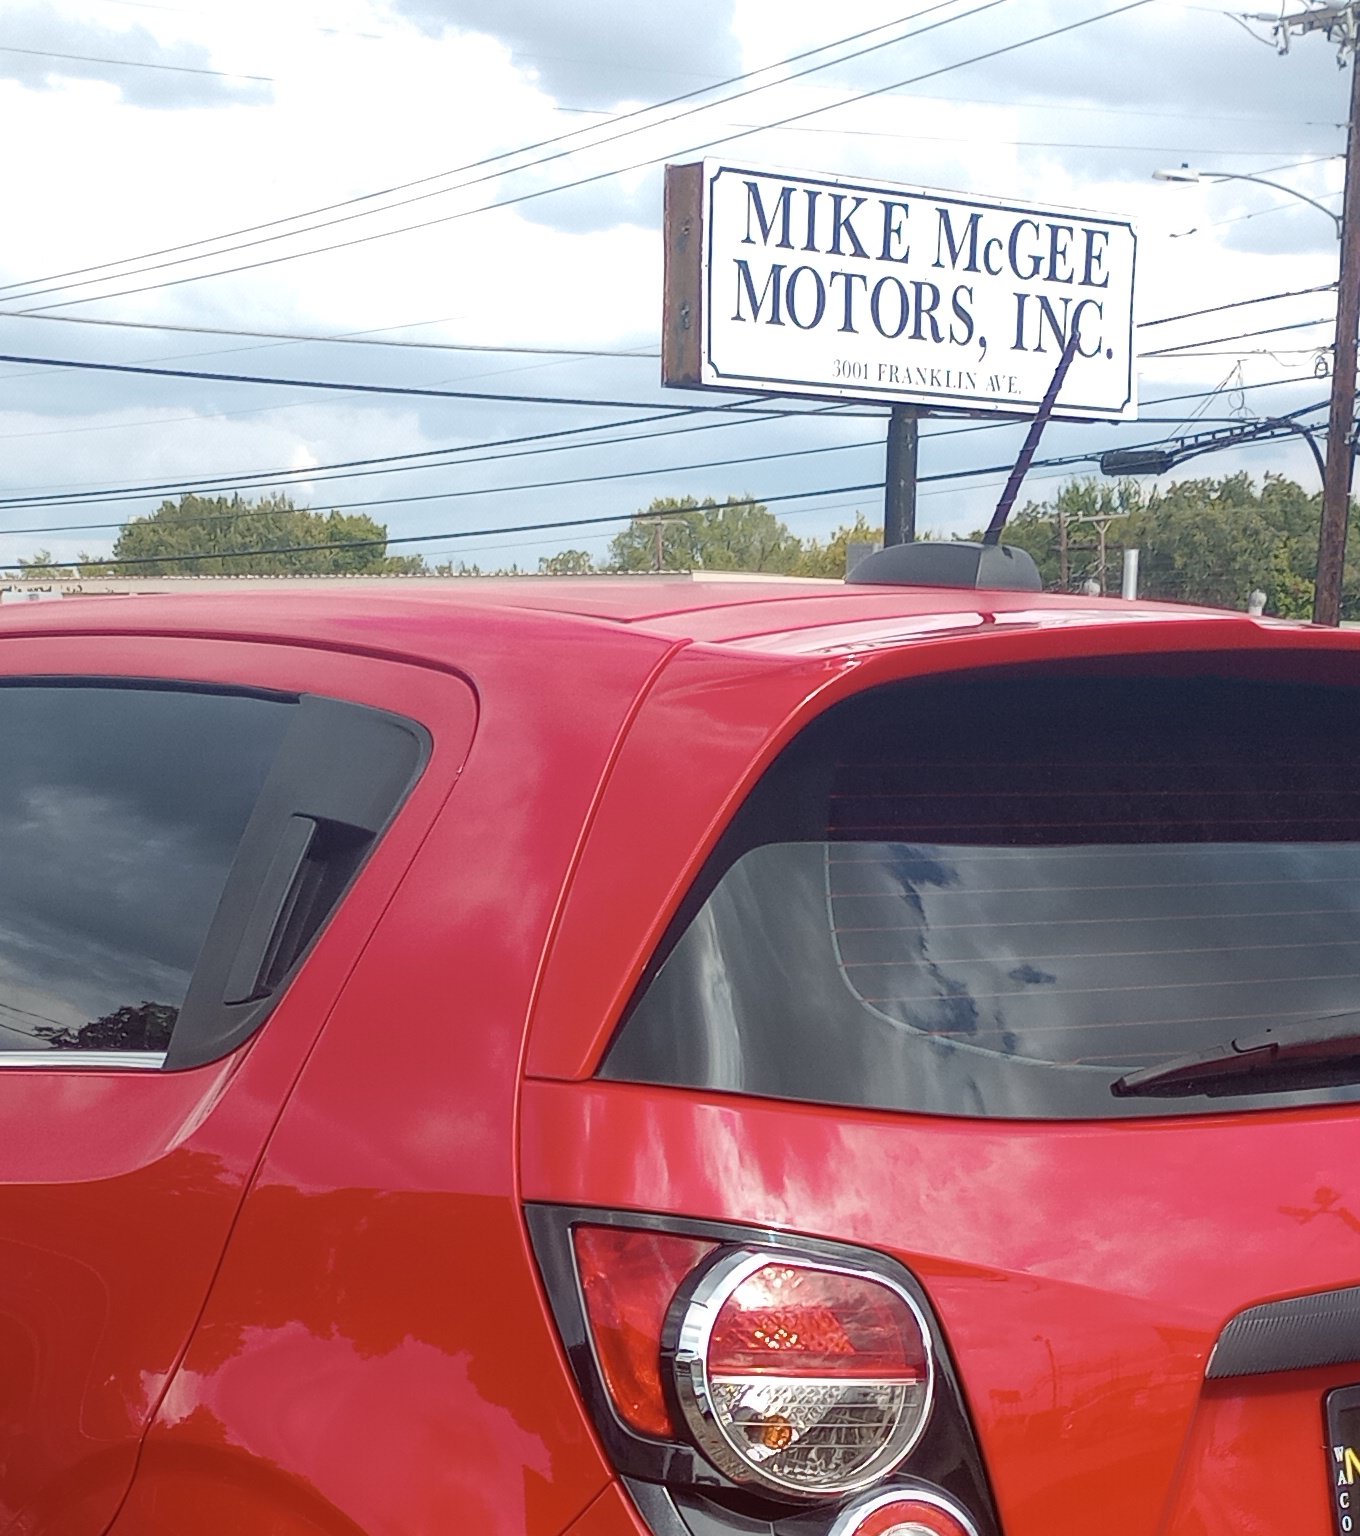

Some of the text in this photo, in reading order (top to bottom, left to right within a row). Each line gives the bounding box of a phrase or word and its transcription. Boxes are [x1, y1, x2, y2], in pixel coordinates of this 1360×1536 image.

[740, 180, 1110, 290] MIKE McGEE
[731, 258, 1114, 363] MOTORS, INC.
[831, 358, 1022, 395] 3001 FRANKLIN AVE.
[1333, 1445, 1353, 1532] WACO
